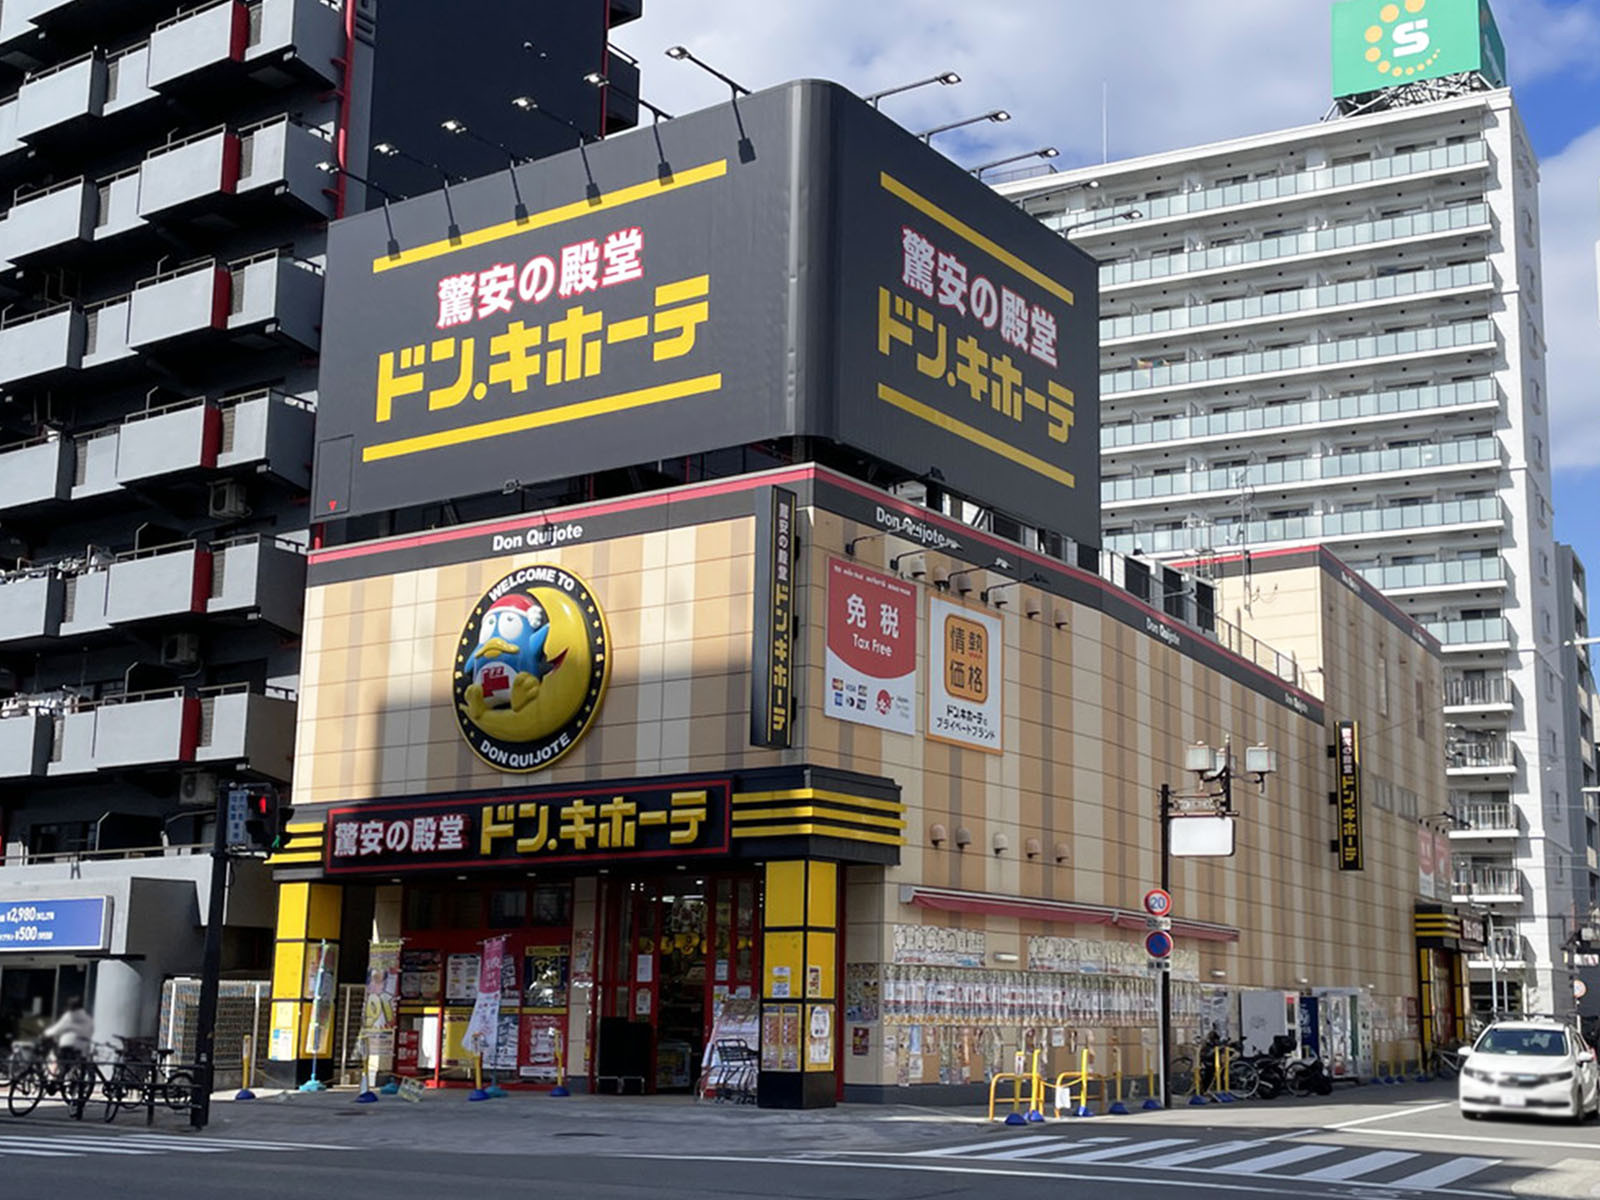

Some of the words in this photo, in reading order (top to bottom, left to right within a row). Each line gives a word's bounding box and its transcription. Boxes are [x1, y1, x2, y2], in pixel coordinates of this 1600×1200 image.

[436, 227, 644, 328] 驚安の殿堂
[902, 226, 1059, 369] 驚安の殿堂
[876, 506, 899, 529] Don
[492, 535, 522, 551] Don
[526, 524, 583, 546] Quijote
[488, 567, 555, 601] WELCOME
[558, 573, 575, 591] TO
[846, 593, 900, 639] 免税
[853, 633, 870, 651] Tax
[872, 639, 892, 657] Free
[480, 740, 507, 764] DON
[509, 732, 571, 767] QUIJOTE
[333, 814, 466, 857] 驚安の殿堂
[1150, 897, 1166, 909] 20
